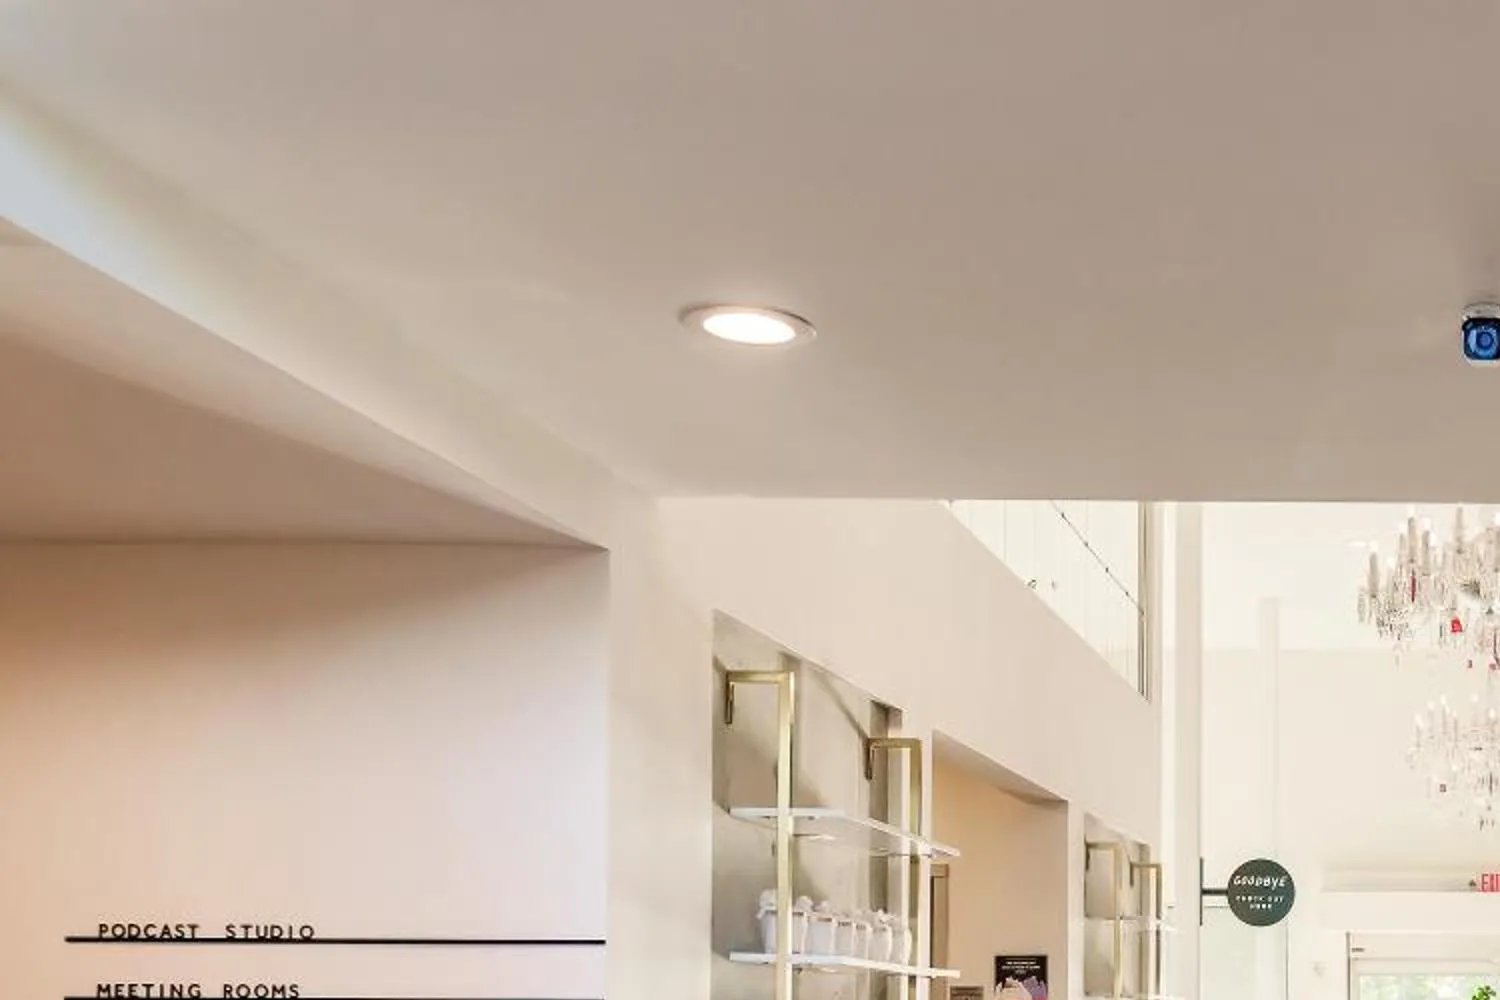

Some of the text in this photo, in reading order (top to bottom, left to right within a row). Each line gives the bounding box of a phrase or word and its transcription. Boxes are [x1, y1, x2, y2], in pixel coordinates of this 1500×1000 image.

[1233, 875, 1288, 891] GOODBYE
[98, 923, 315, 941] PODCAST STUDIO
[96, 983, 300, 999] MEETING ROOMS
